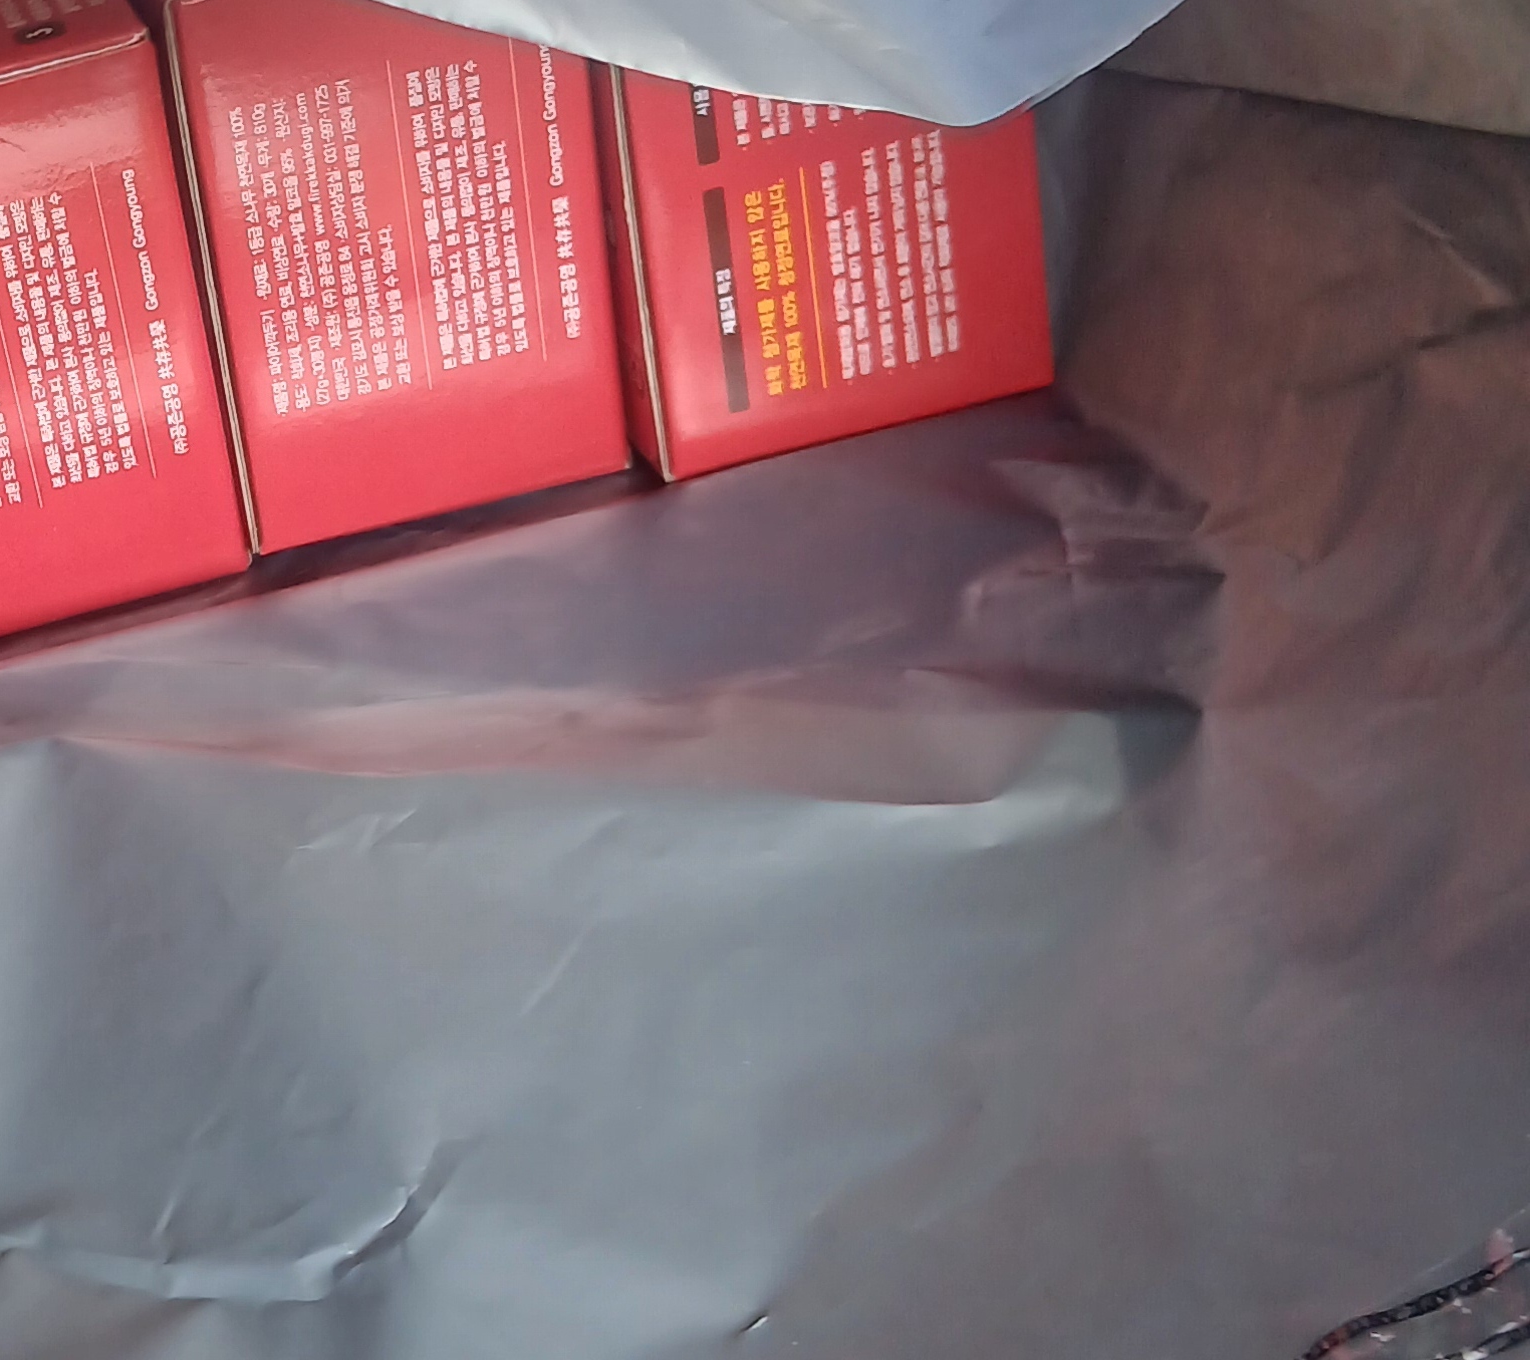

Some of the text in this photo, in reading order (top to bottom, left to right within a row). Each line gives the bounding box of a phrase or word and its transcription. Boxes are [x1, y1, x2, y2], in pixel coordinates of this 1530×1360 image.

[46, 187, 63, 206] 수
[121, 167, 147, 249] Gongyoung
[743, 189, 765, 224] 않은
[28, 192, 51, 243] 판매하는
[49, 205, 67, 231] 처할
[15, 233, 36, 270] 디자인
[54, 230, 76, 270] 벌금에
[747, 227, 772, 291] 사용하지
[62, 267, 83, 305] 이하의
[137, 249, 159, 311] Gongzon
[766, 177, 807, 390] 천연목재 100% 청정연료입니다.
[49, 297, 73, 343] 동의없이
[16, 322, 38, 368] 제품으로
[34, 320, 55, 358] 제품의
[59, 344, 79, 369] 본사
[96, 329, 114, 356] 있는
[44, 356, 60, 372] 본
[78, 345, 102, 392] 징역이나
[101, 354, 122, 401] 보호하고
[25, 366, 46, 401] 근거한
[65, 367, 88, 412] 근거하여
[88, 390, 108, 426] 이하의
[57, 417, 76, 452] 다하고
[73, 410, 95, 445] 규정에
[96, 425, 113, 447] 5년
[0, 457, 17, 482] 또는
[43, 441, 64, 476] 제품은
[80, 443, 101, 478] 특허법
[101, 448, 120, 474] 경우
[116, 434, 138, 470] 있도록
[3, 479, 22, 505] 교환
[49, 473, 67, 488] 본
